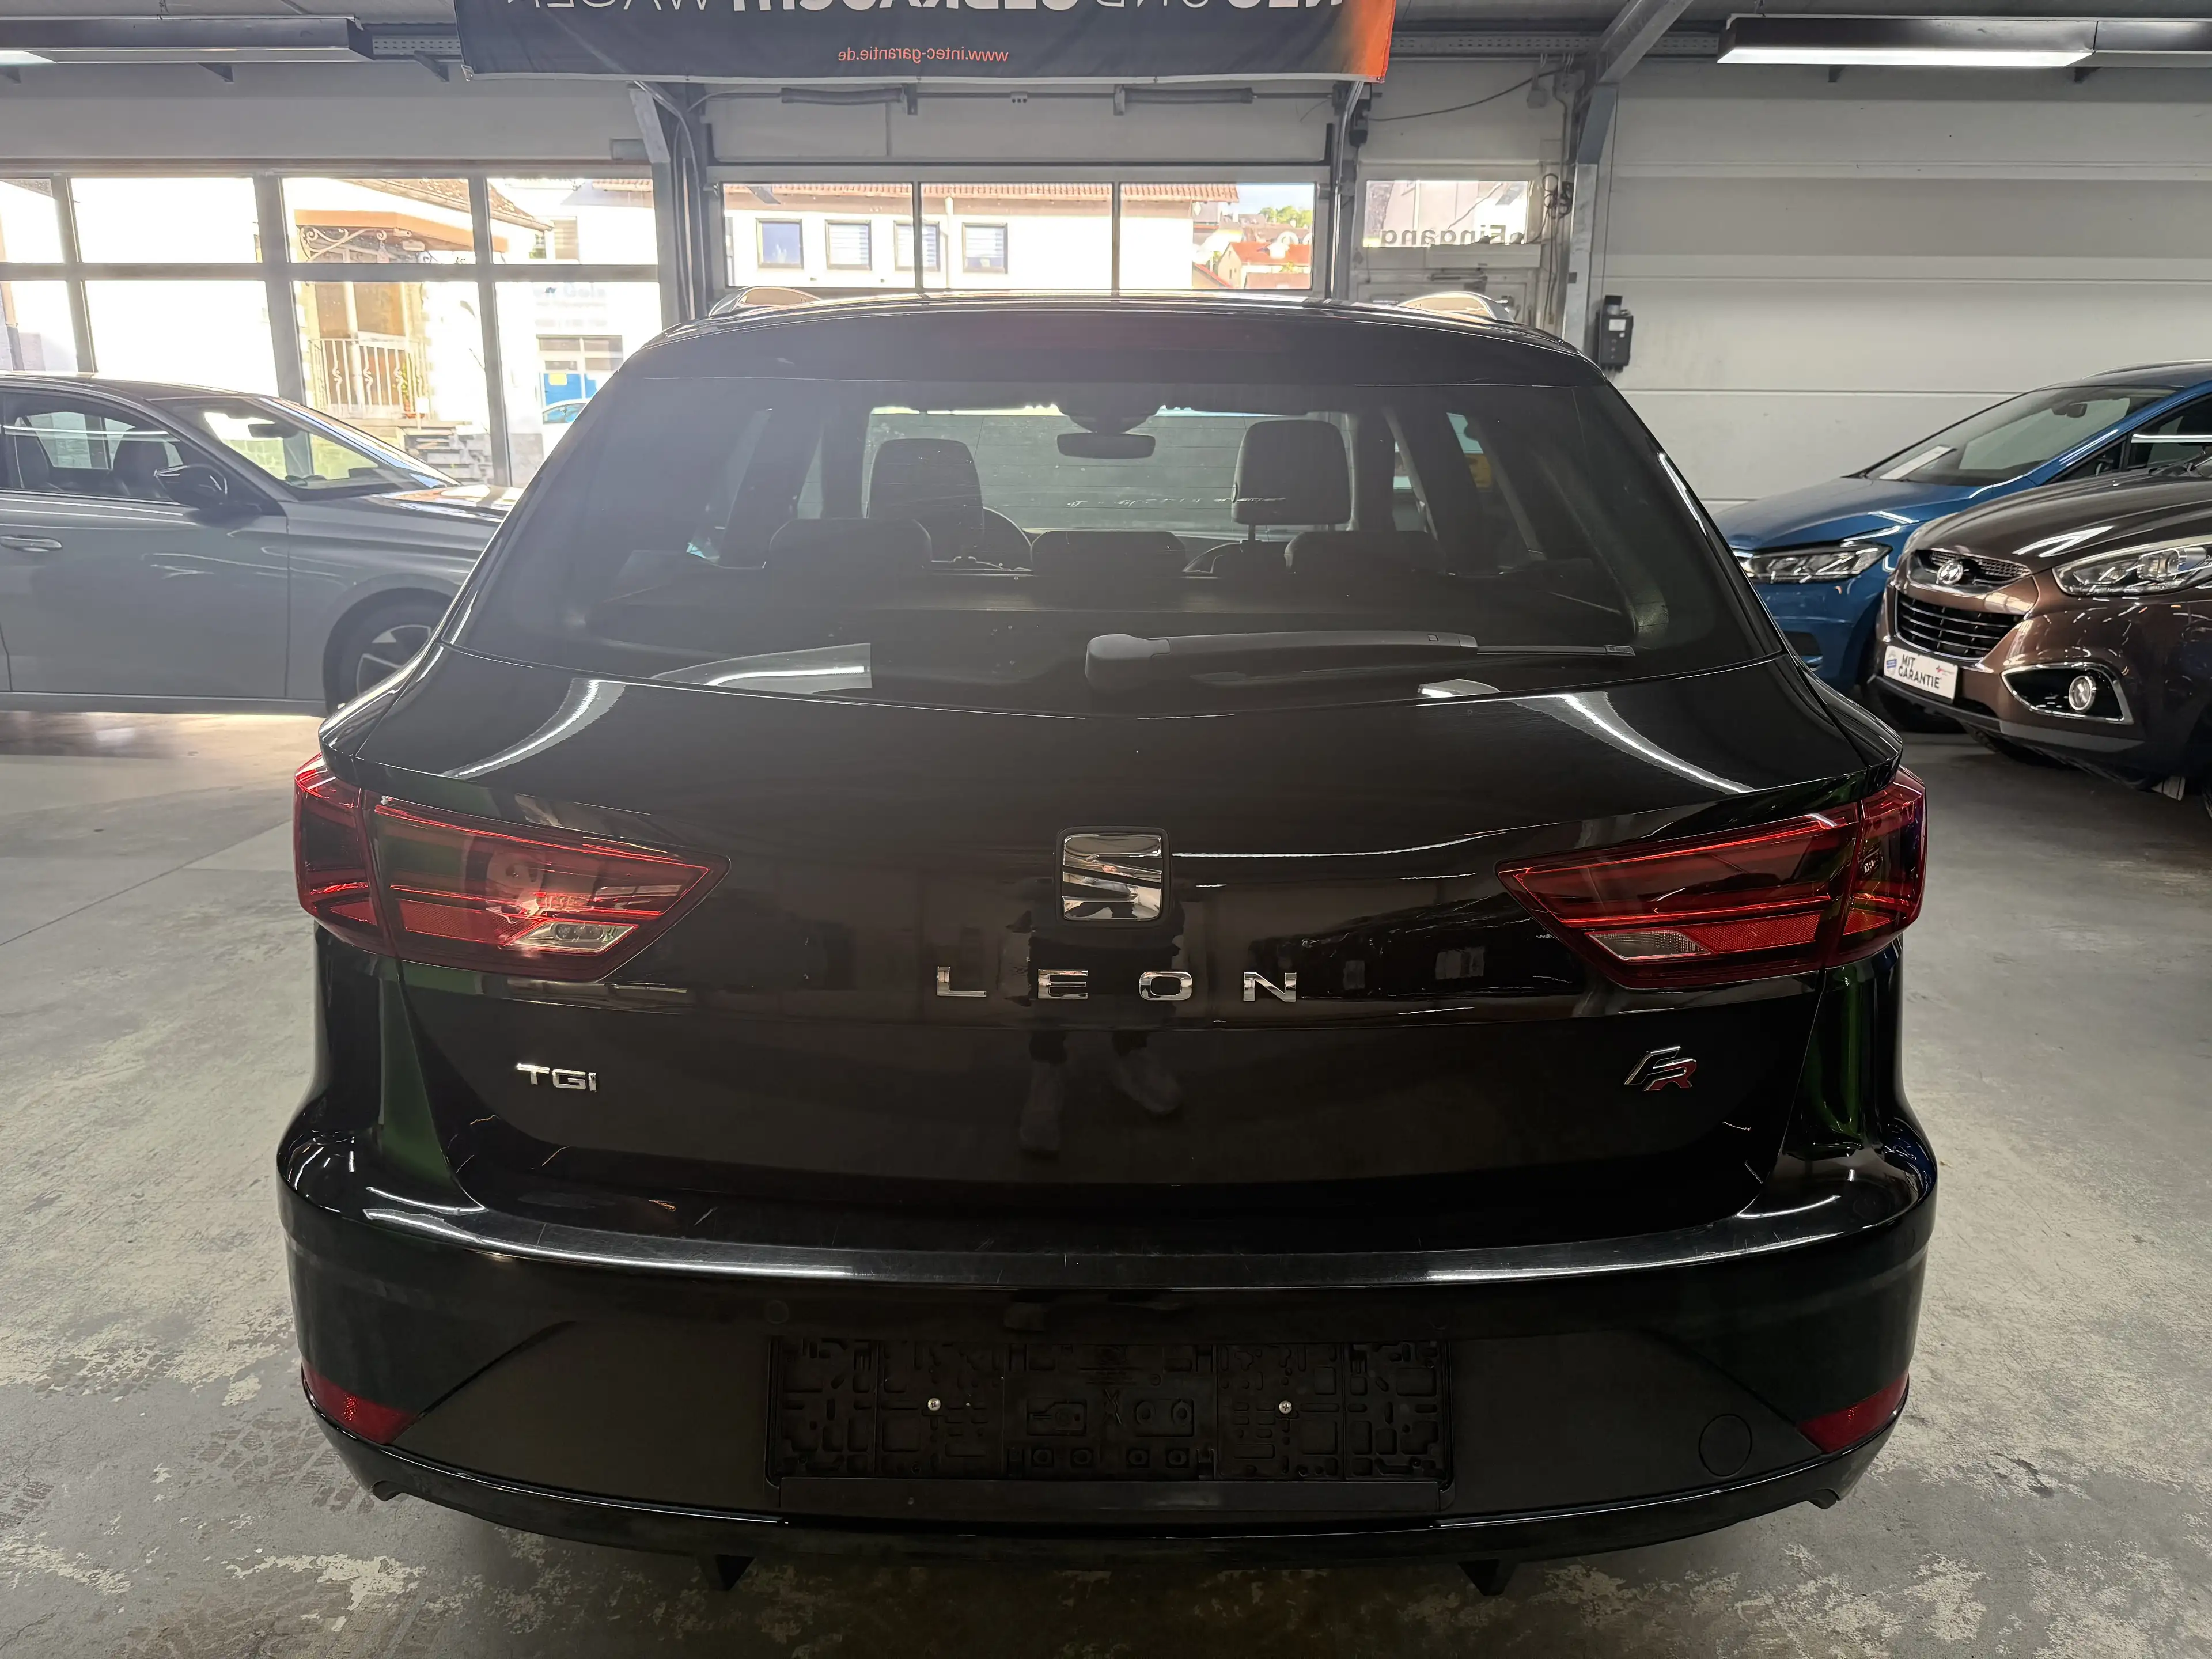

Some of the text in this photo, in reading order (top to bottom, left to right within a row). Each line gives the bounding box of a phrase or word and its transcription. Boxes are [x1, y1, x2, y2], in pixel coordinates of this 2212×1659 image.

[1901, 654, 1916, 669] MIT
[1897, 666, 1940, 690] GARANTIE
[937, 966, 1297, 1003] LEON
